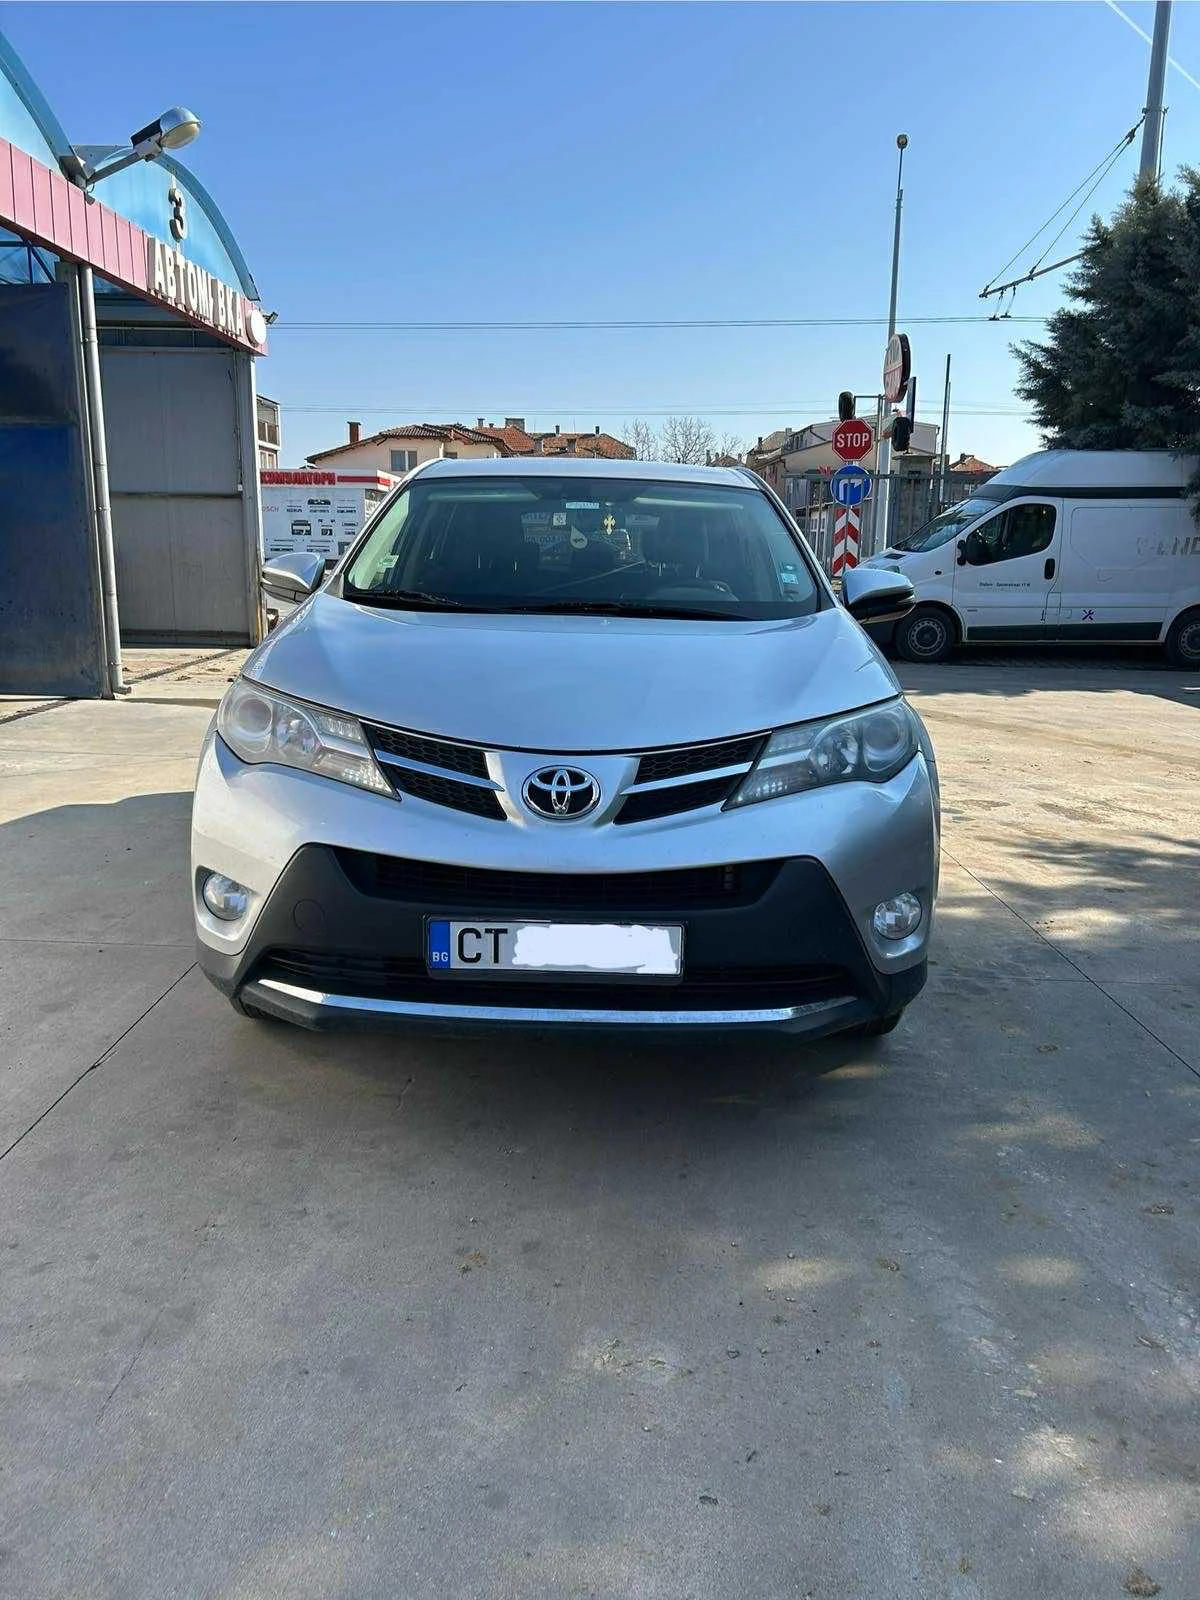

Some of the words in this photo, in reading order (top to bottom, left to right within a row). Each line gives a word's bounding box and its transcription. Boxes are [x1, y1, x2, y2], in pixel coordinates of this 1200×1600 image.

[168, 187, 188, 242] 3
[836, 432, 870, 449] STOP
[432, 951, 449, 963] BG
[457, 927, 508, 964] CT
